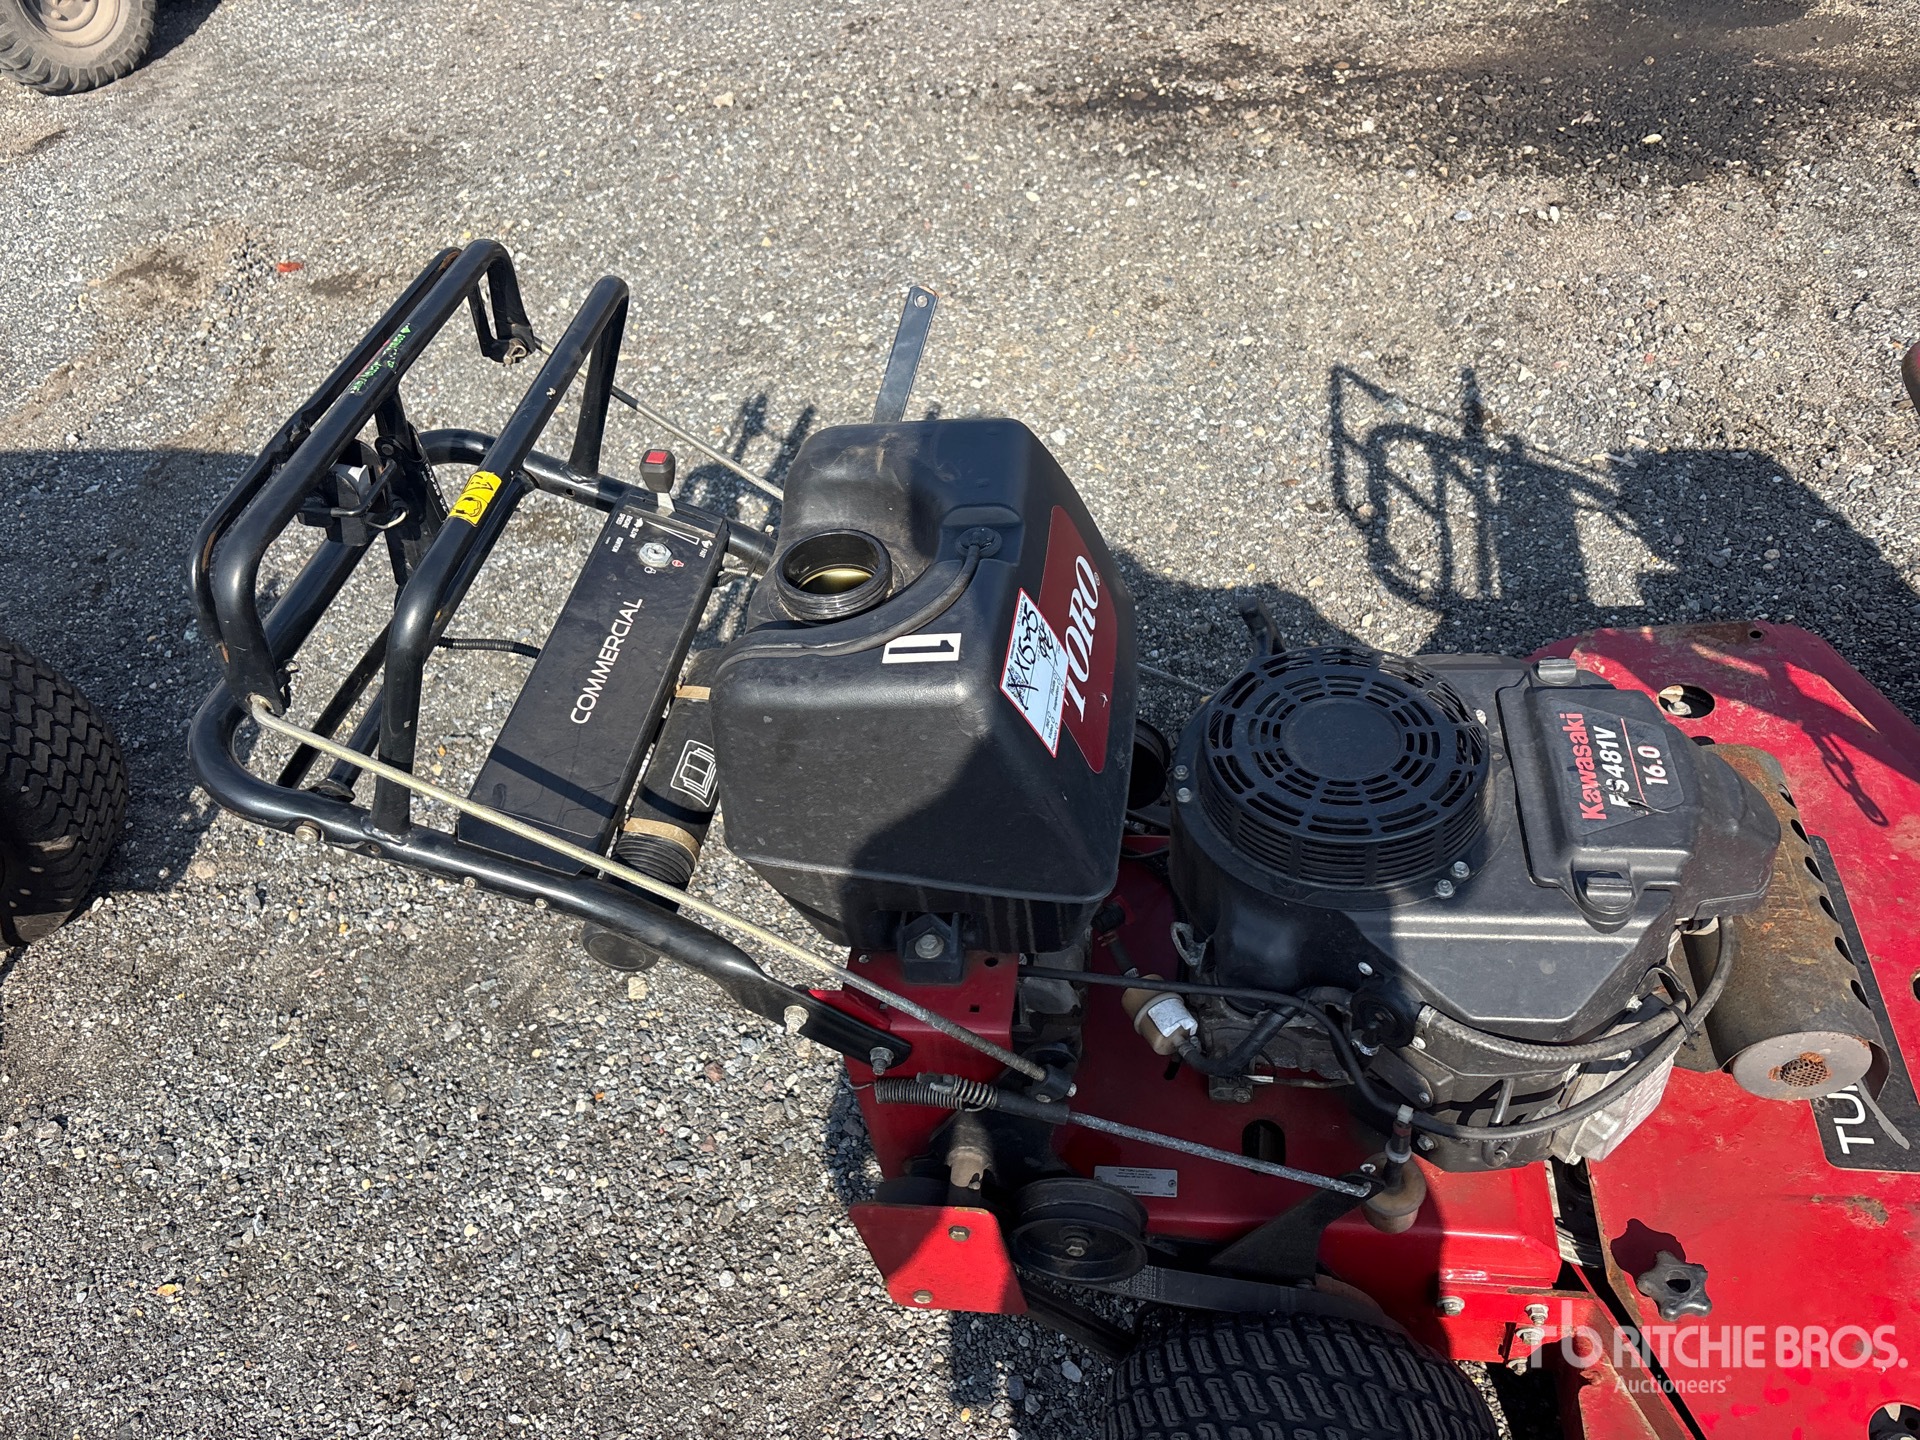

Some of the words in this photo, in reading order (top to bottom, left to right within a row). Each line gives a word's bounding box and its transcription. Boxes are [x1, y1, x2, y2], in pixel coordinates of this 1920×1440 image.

[569, 598, 643, 724] COMMERCIAL
[1064, 555, 1100, 722] TORO
[1559, 713, 1607, 820] Kawasaki
[1593, 725, 1631, 808] FS481V
[1637, 745, 1669, 786] 16.0
[1826, 1085, 1876, 1155] TU
